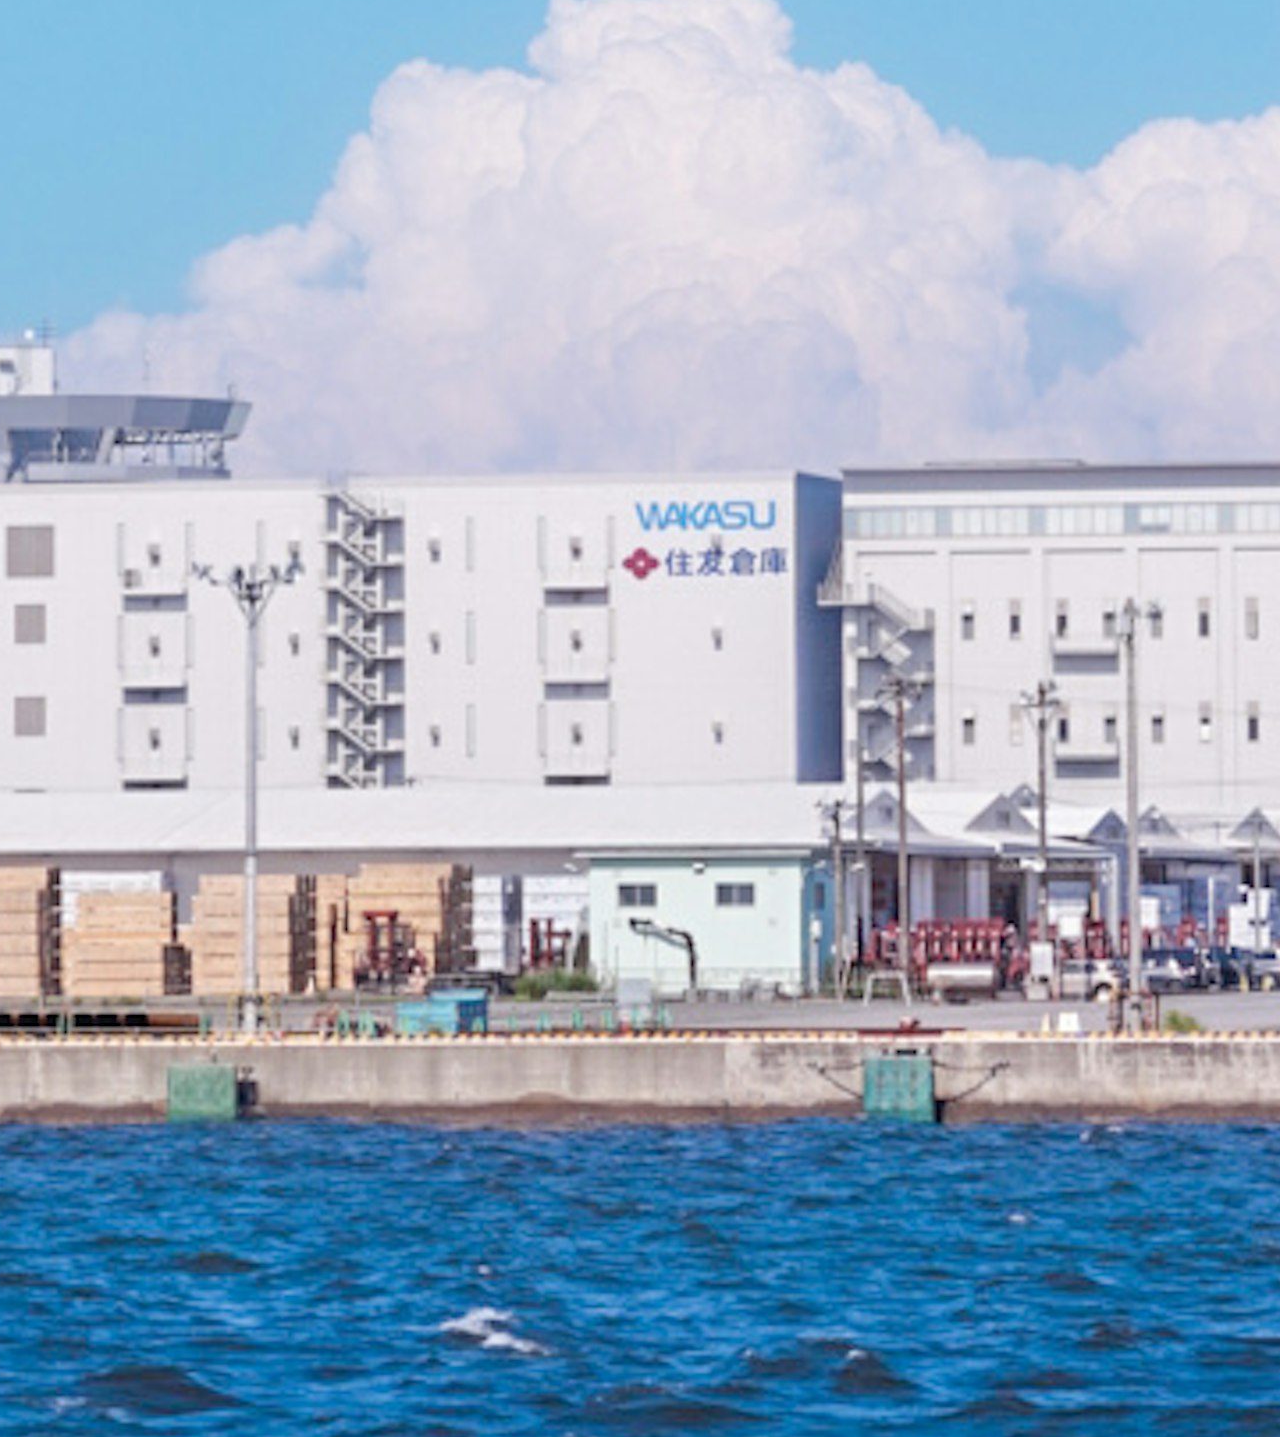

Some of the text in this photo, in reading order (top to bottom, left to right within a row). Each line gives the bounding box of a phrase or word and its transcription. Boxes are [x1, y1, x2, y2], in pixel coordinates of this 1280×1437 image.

[635, 501, 776, 531] WAKASU
[665, 546, 787, 576] 住友倉庫
